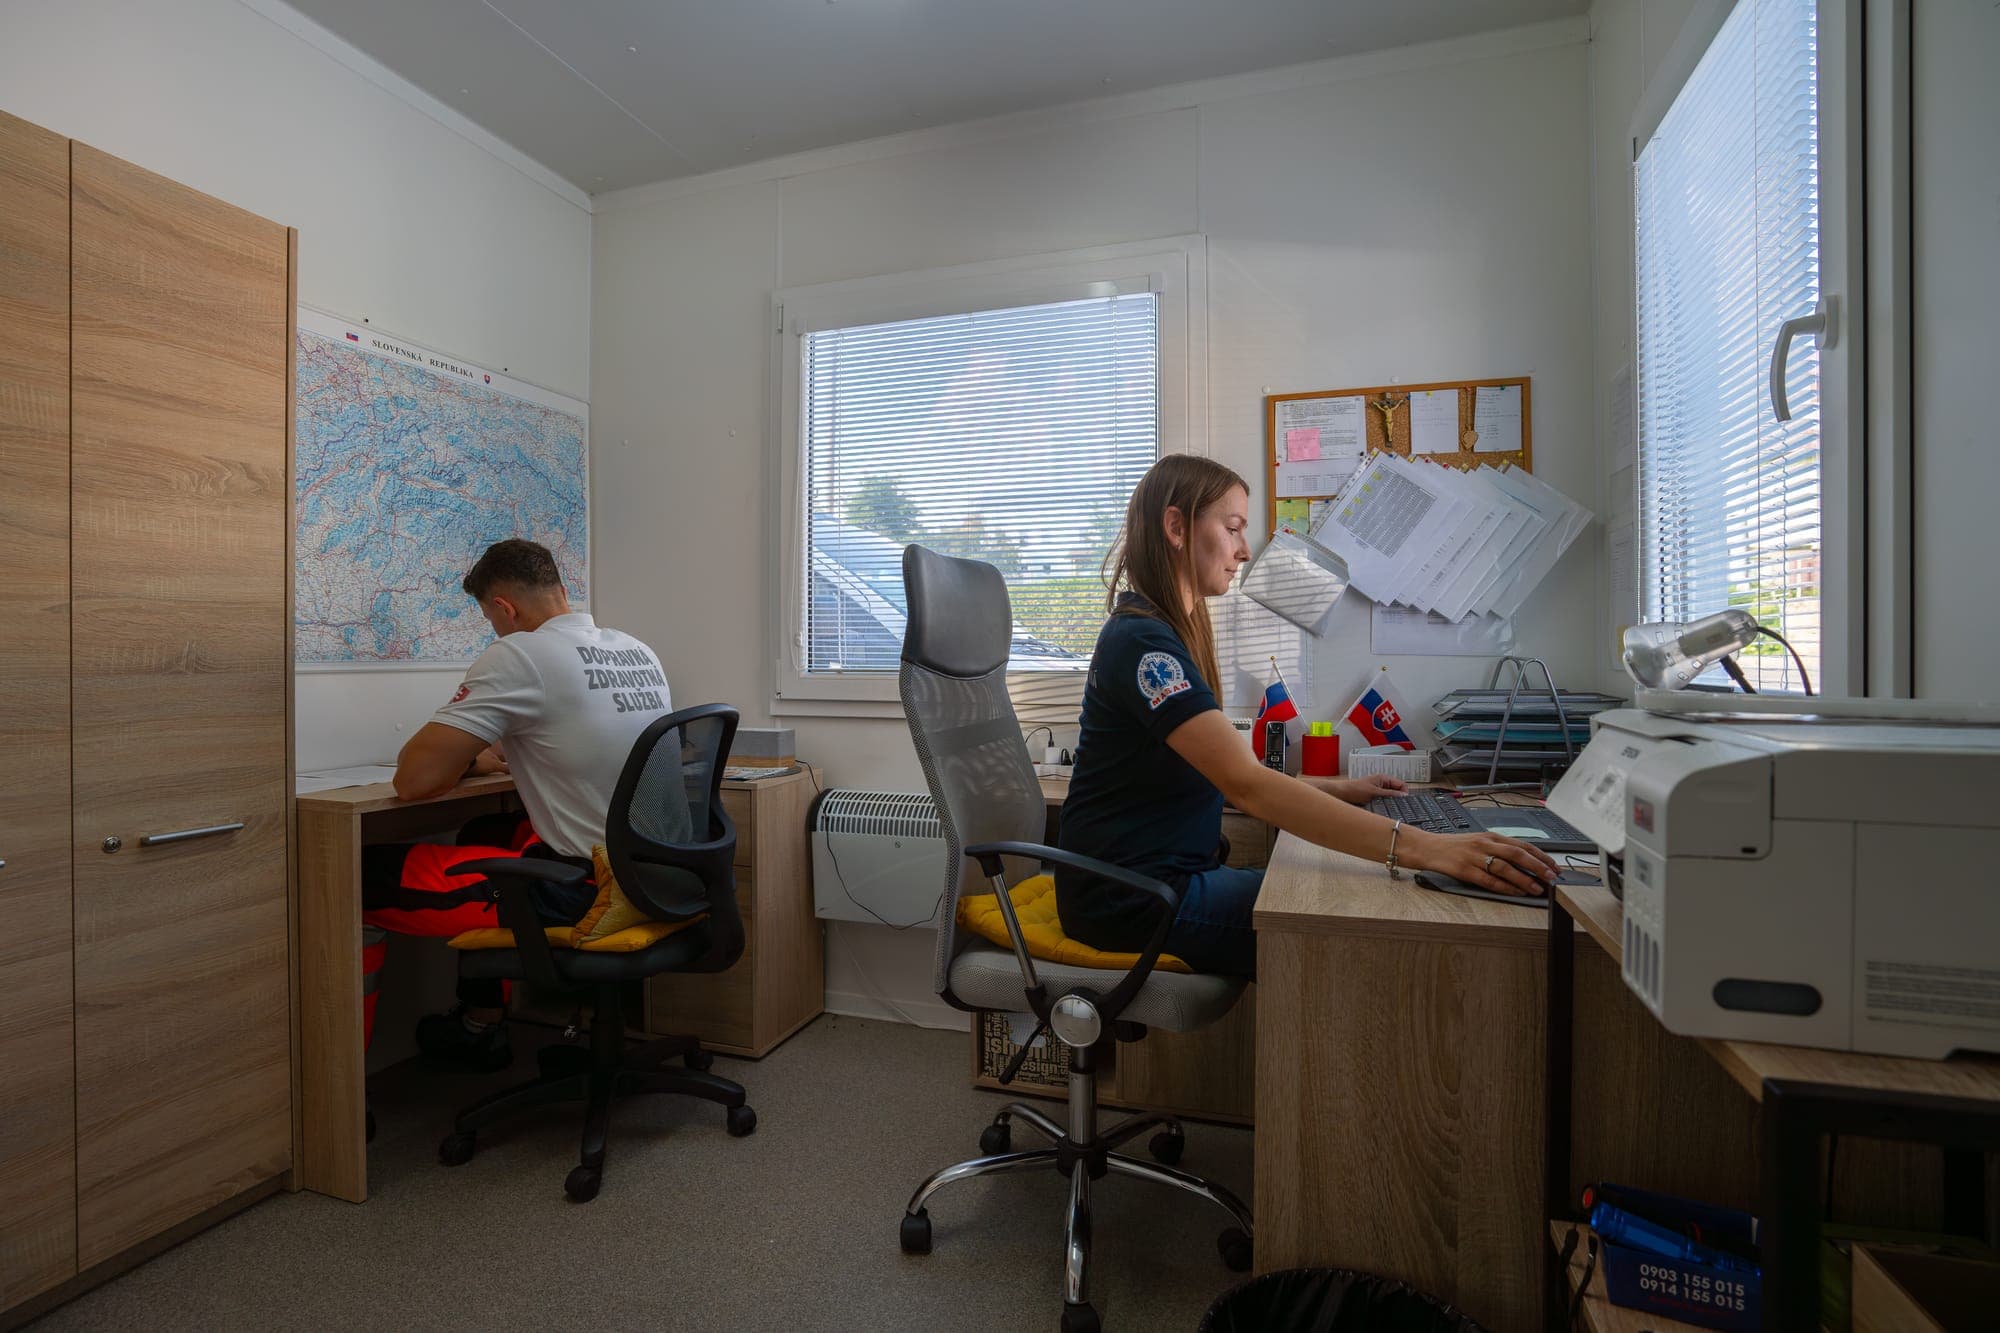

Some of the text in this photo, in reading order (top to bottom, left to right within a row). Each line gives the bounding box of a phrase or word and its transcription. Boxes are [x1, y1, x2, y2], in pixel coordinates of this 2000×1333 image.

[372, 339, 474, 379] SLOVENSKÁ REPUBLIKA
[576, 646, 653, 666] DOPRAVNÁ
[584, 665, 665, 690] ZDRAVOTNÁ
[612, 688, 665, 713] SLUŽBA
[1021, 1060, 1058, 1075] esign
[1640, 1264, 1745, 1296] 0903 155 015
[1640, 1278, 1677, 1296] 0914
[1684, 1287, 1710, 1303] 155
[1715, 1295, 1745, 1311] 015
